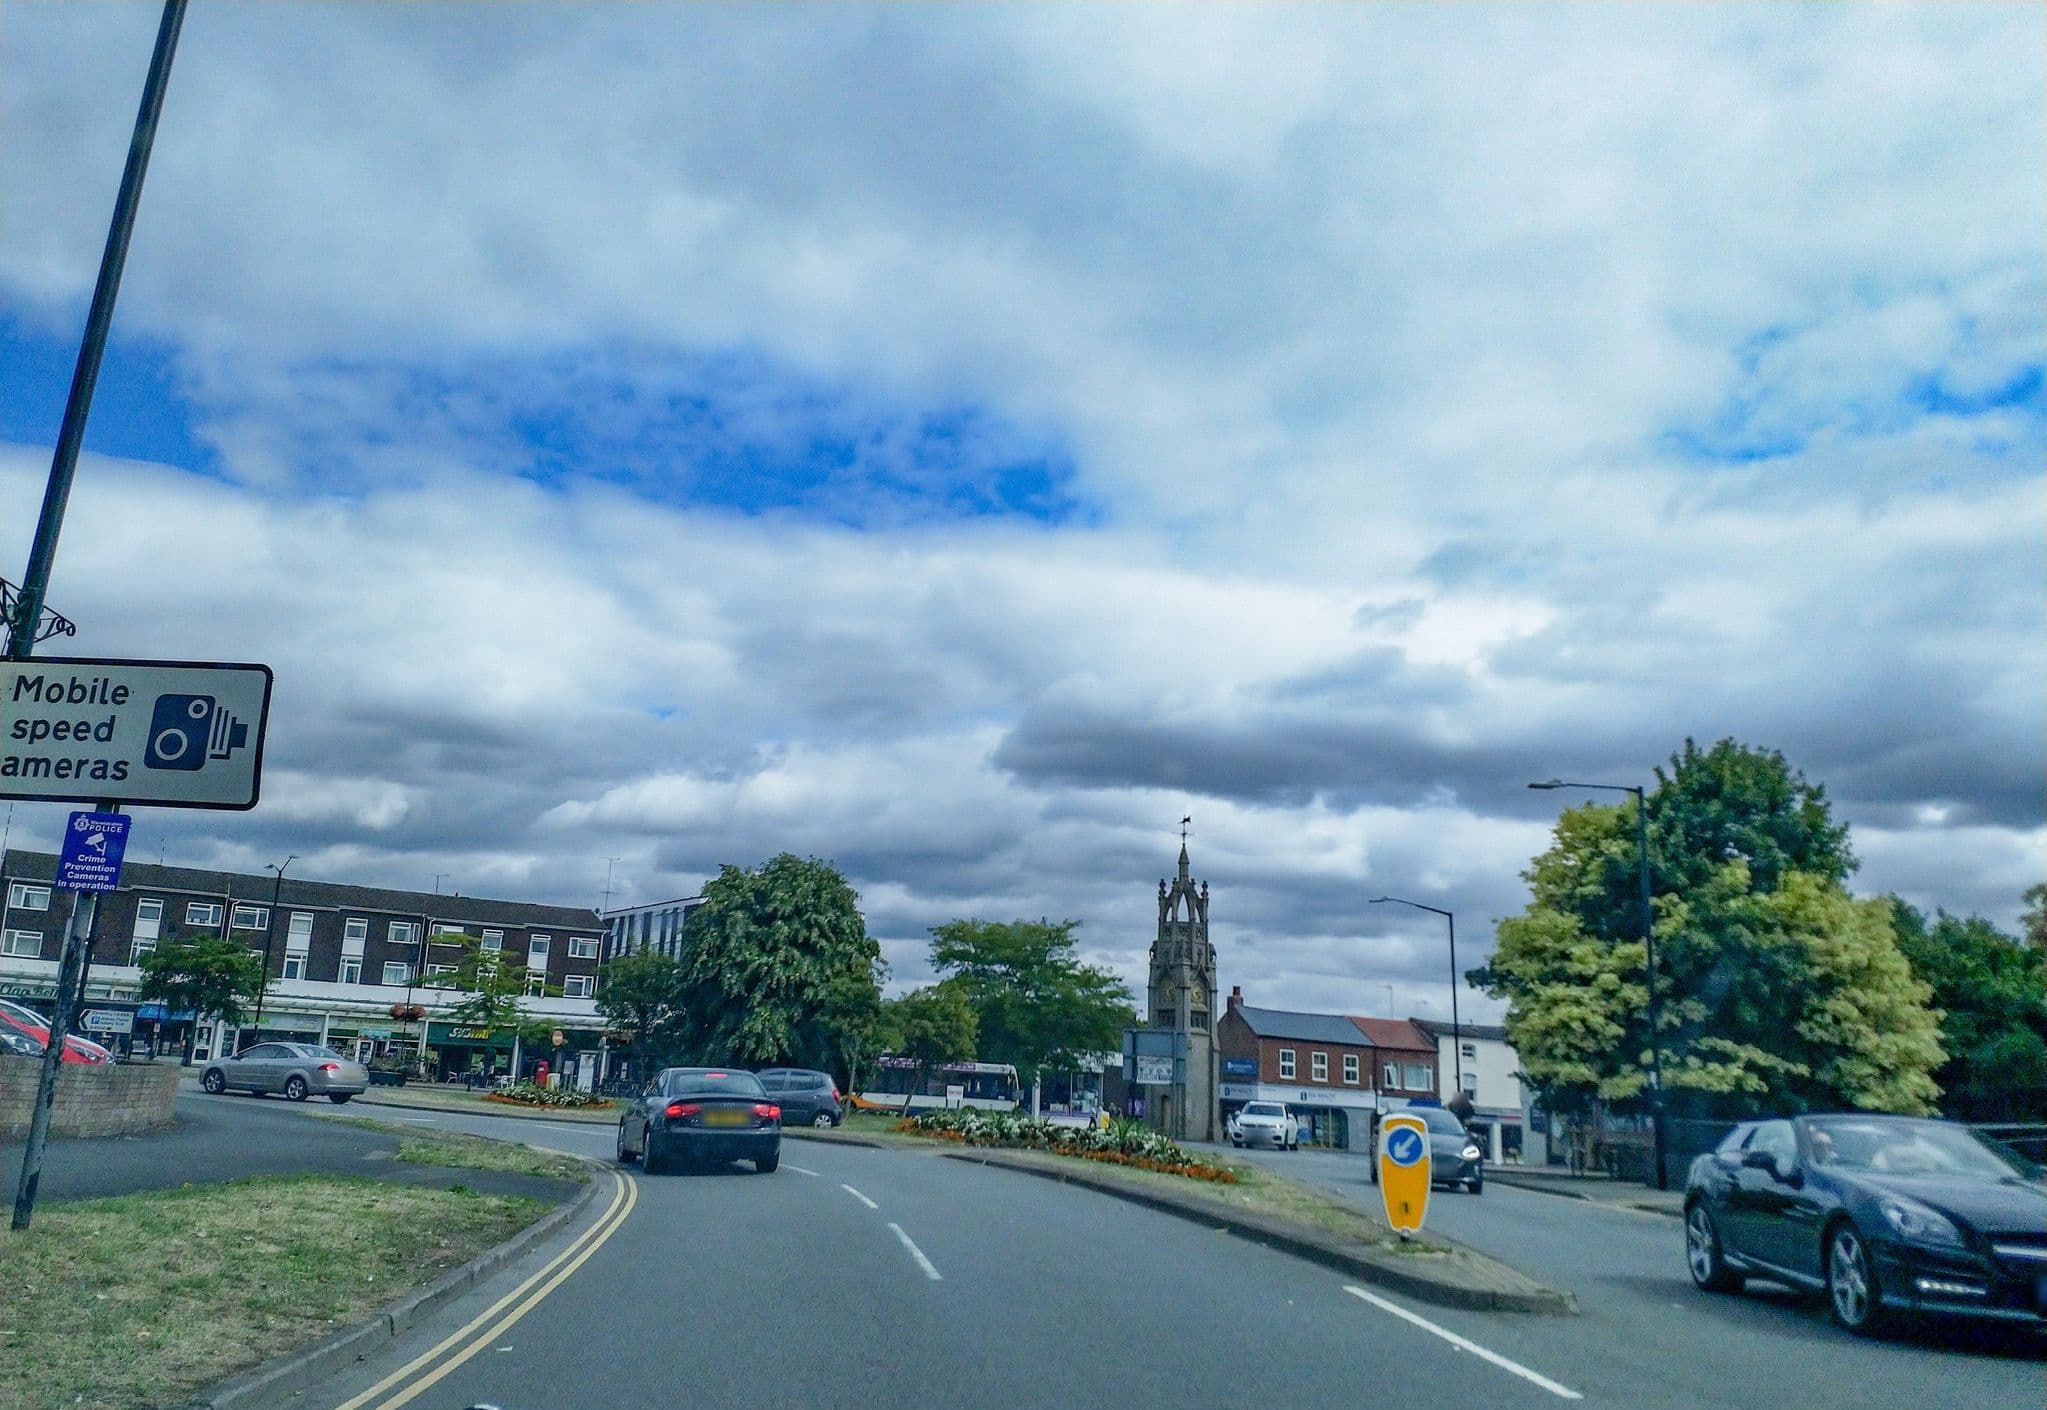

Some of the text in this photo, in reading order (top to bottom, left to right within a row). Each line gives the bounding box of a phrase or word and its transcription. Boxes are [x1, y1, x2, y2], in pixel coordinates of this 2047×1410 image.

[13, 675, 129, 705] Mobile
[10, 715, 116, 744] speed
[0, 757, 130, 781] ameras
[89, 824, 123, 833] POLICE
[78, 854, 106, 863] Crime
[64, 862, 116, 872] Prevention
[67, 871, 110, 881] Cameras
[69, 881, 115, 890] operation
